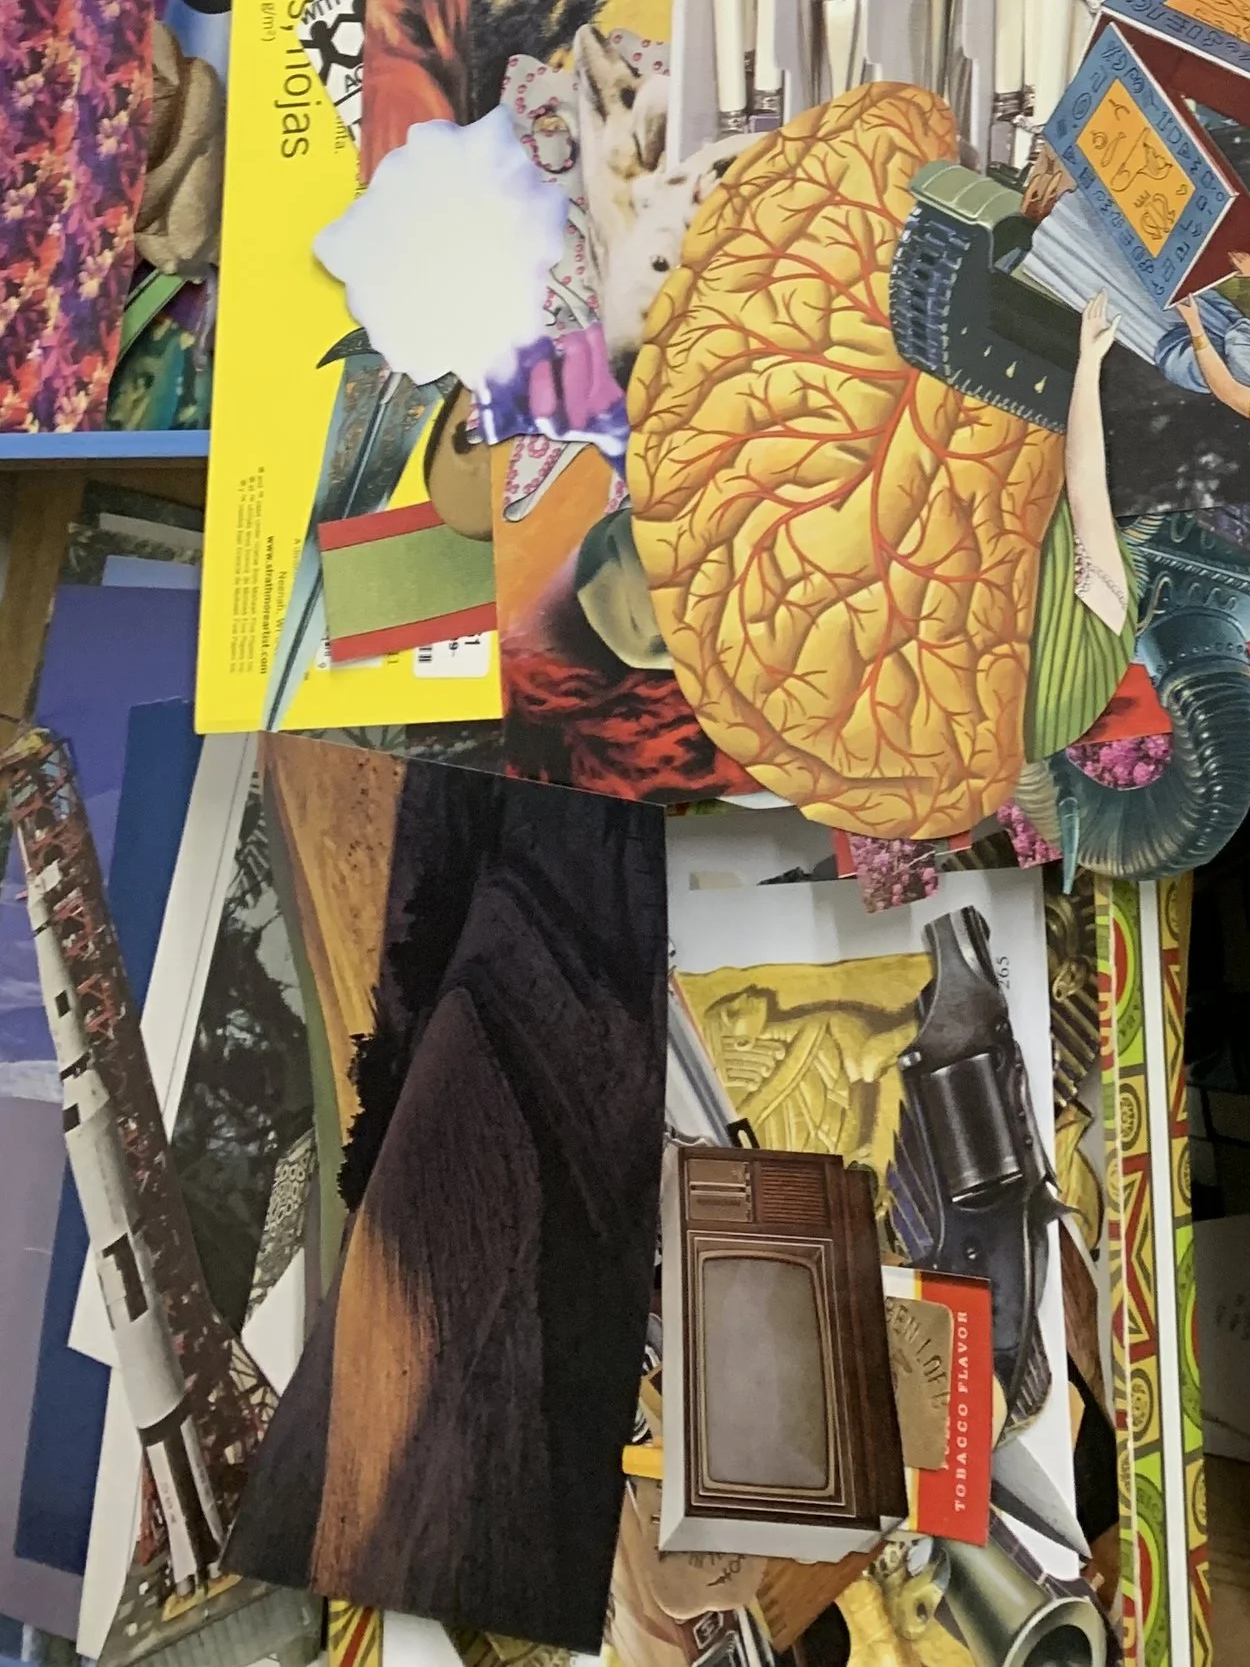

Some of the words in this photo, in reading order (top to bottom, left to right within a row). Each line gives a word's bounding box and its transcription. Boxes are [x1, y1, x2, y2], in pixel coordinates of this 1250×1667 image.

[260, 536, 274, 674] www.strathmoreartist.com
[275, 571, 287, 615] Neenah,
[995, 956, 1009, 989] 265
[956, 1311, 968, 1394] FLAVOR
[954, 1404, 967, 1512] TOBACCO
